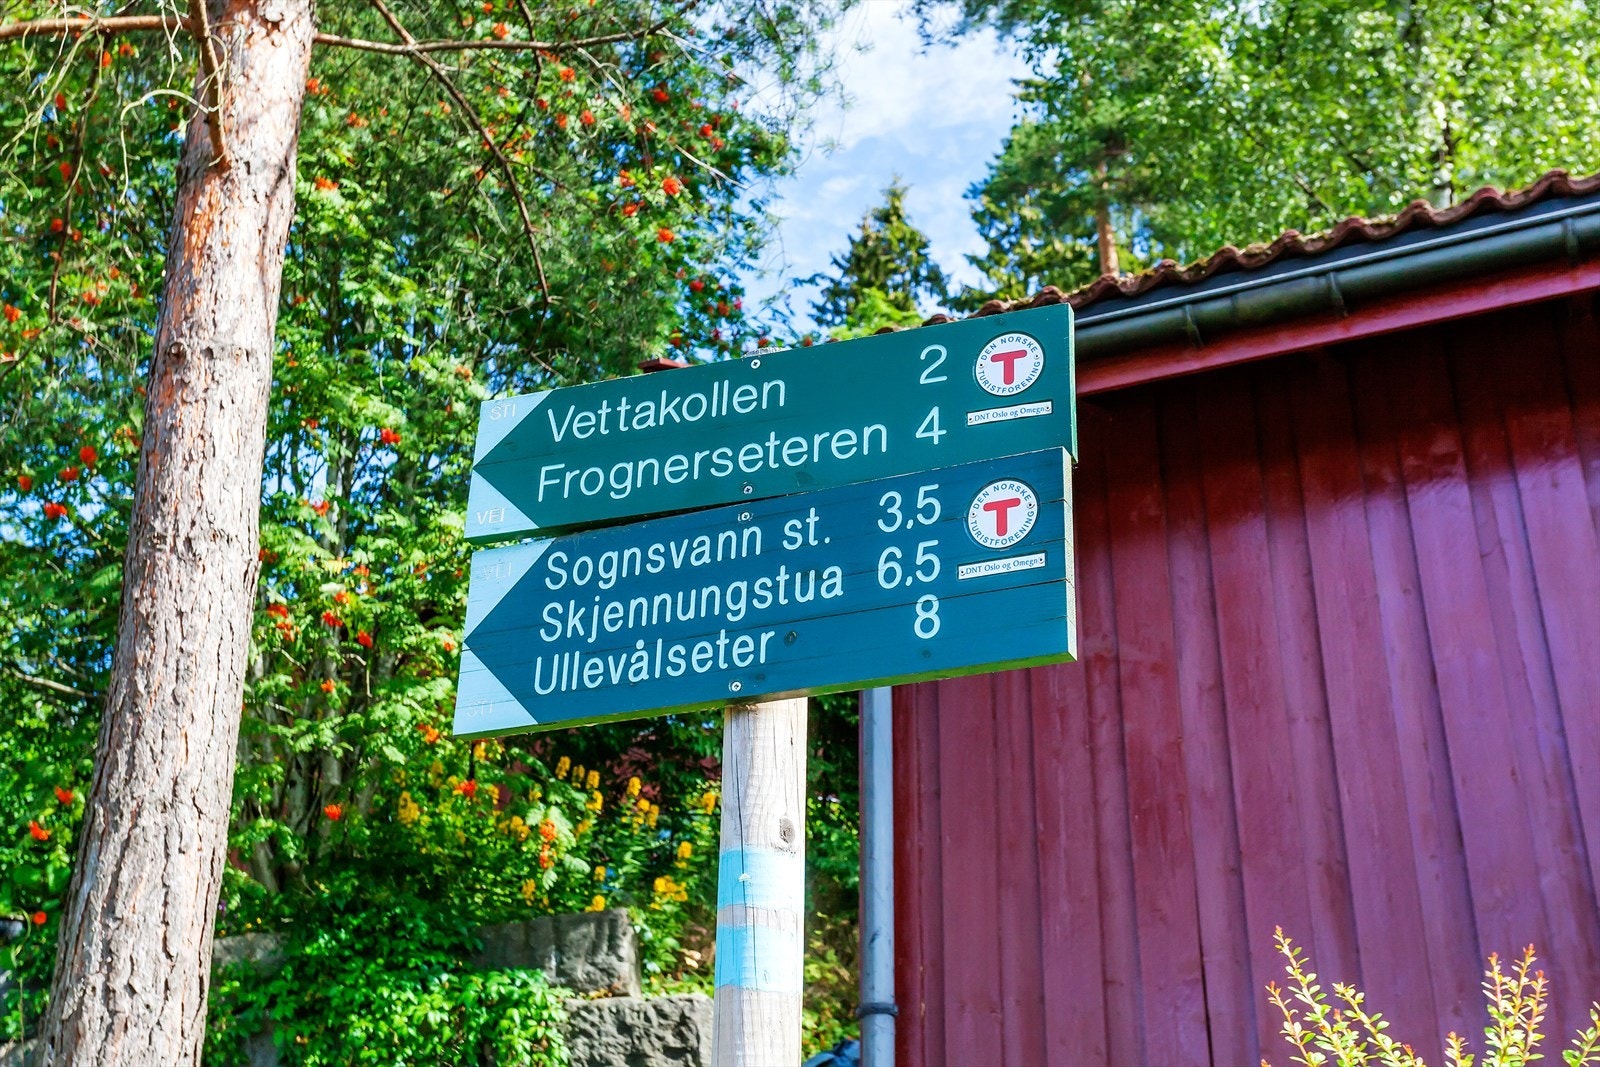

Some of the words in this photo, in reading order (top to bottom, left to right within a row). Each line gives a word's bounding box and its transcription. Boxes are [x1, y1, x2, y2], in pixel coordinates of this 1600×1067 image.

[919, 344, 948, 385] 2
[980, 343, 997, 361] DEN
[1000, 336, 1039, 353] NORSKE
[990, 349, 1028, 386] T
[977, 361, 1041, 394] TURISTFORENING
[490, 403, 516, 420] STI
[547, 379, 786, 443] Vettakollen
[915, 405, 947, 445] 4
[974, 413, 990, 422] DNT
[992, 411, 1008, 419] Oslo
[1020, 406, 1045, 415] Omegn
[538, 423, 887, 502] Frognerseteren
[477, 508, 505, 525] VEI
[877, 483, 941, 533] 3,5
[973, 490, 990, 510] DEN
[993, 483, 1032, 502] NORSKE
[970, 511, 1035, 546] TURISTFORENING
[983, 497, 1021, 537] T
[545, 525, 762, 590] Sognsvann
[782, 507, 831, 550] st.
[877, 539, 941, 590] 6,5
[965, 565, 982, 575] DNT
[984, 563, 1000, 571] Oslo
[1002, 562, 1011, 570] og
[1013, 557, 1038, 567] Omegn
[539, 564, 843, 643] Skjennungstua
[913, 593, 941, 640] 8
[534, 628, 775, 696] Ullevålseter
